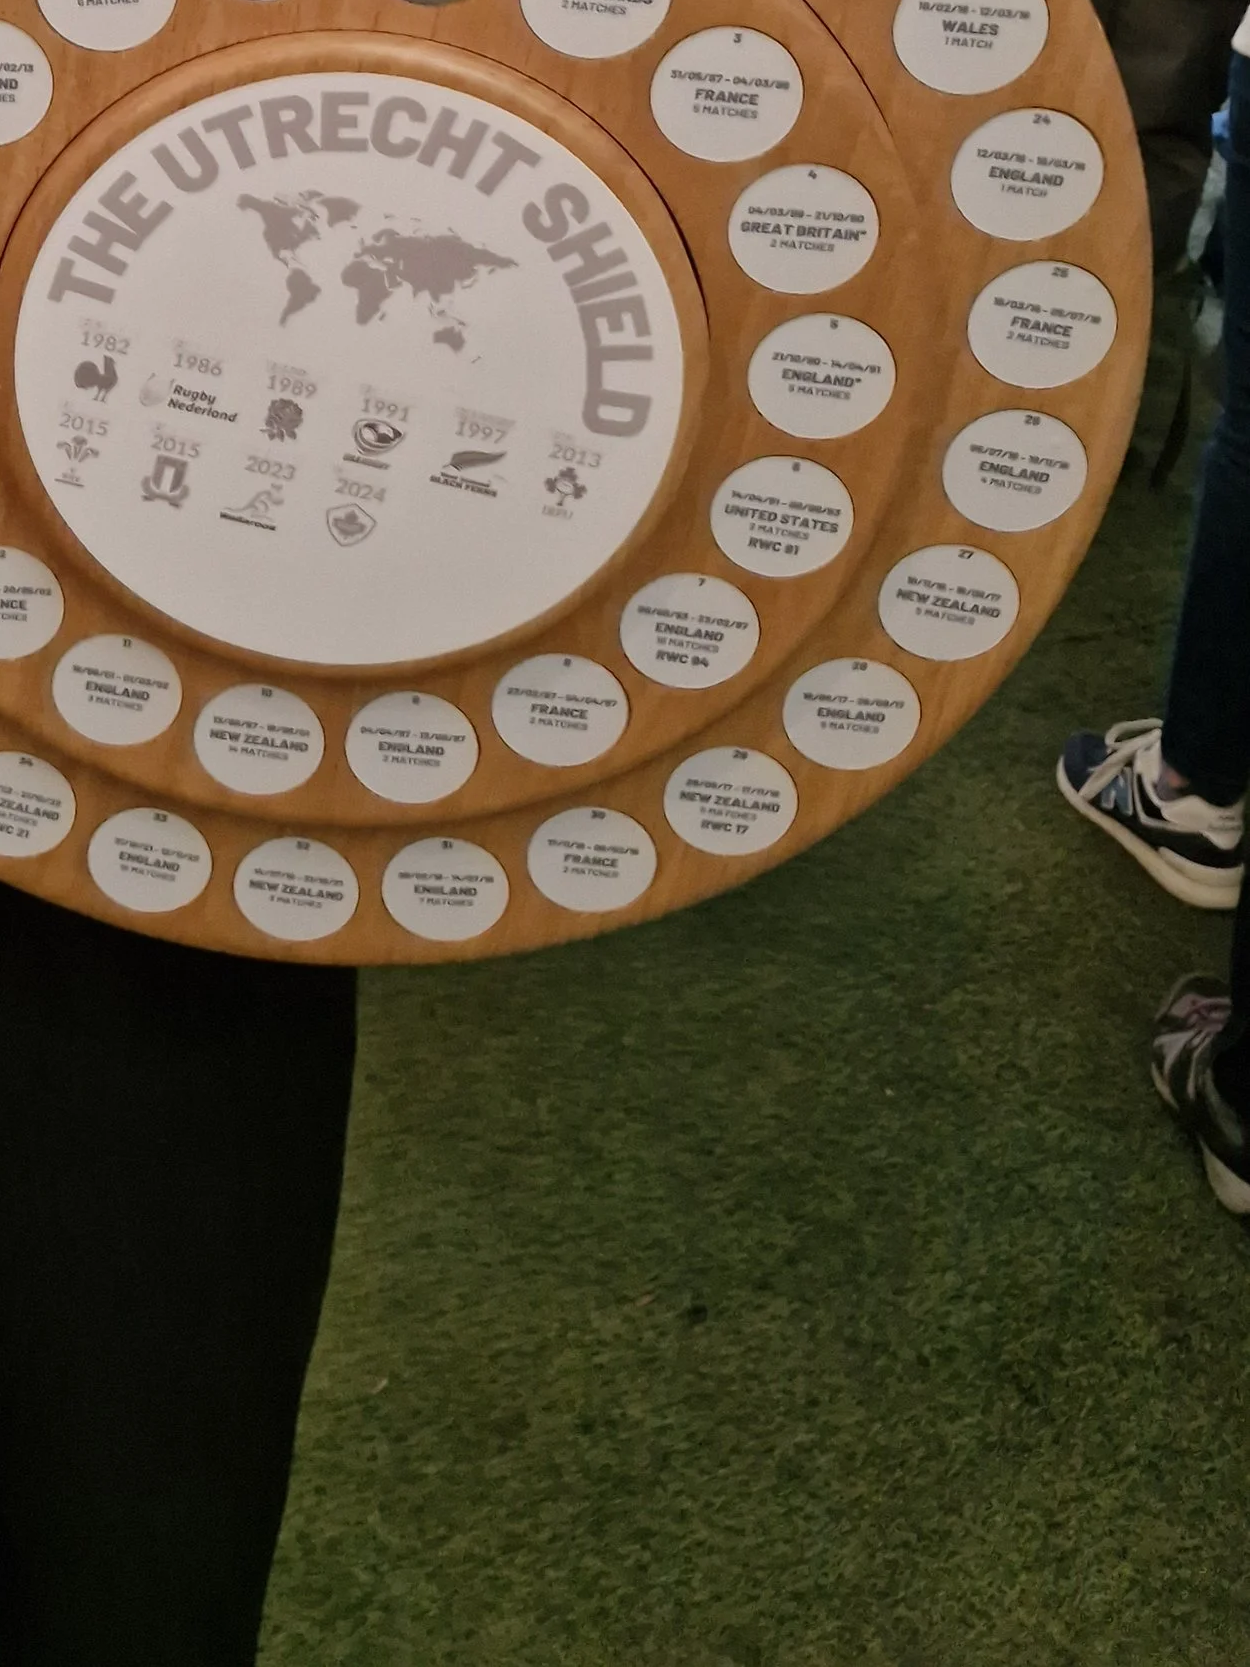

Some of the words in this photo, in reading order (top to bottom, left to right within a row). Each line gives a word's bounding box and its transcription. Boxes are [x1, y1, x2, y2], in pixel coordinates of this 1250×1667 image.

[561, 0, 569, 8] 2
[571, 0, 627, 15] MATCHES
[942, 20, 999, 36] WALES
[734, 34, 742, 43] 3
[951, 38, 993, 49] MATCH
[695, 88, 759, 106] FRANCE
[702, 105, 758, 119] MATCHES
[808, 170, 817, 179] 4
[988, 166, 1063, 187] ENGLAND
[1007, 185, 1047, 198] MATCH
[741, 221, 794, 235] GREAT
[770, 239, 777, 247] 2
[780, 241, 835, 252] MATCHES
[47, 170, 173, 305] THE
[151, 92, 541, 197] UTRECHT
[521, 183, 654, 438] SHIELD
[1010, 316, 1073, 337] FRANCE
[81, 331, 130, 355] 1982
[174, 353, 222, 376] 1986
[173, 385, 216, 405] Rugby
[268, 375, 317, 398] 1989
[798, 386, 850, 400] MATCHES
[361, 398, 409, 422] 1991
[59, 413, 109, 436] 2015
[456, 421, 508, 444] 1997
[151, 434, 200, 459] 2015
[549, 444, 601, 468] 2013
[245, 455, 296, 481] 2023
[979, 461, 1050, 483] ENGLAND
[336, 479, 386, 502] 2024
[724, 504, 777, 522] UNITED
[780, 513, 839, 533] STATES
[748, 537, 782, 553] RWC
[958, 549, 974, 559] 27
[698, 577, 705, 586] 7
[896, 589, 930, 604] NEW
[932, 597, 1000, 618] ZEALAND
[655, 622, 724, 642] ENGLAND
[656, 650, 688, 664] RWC
[86, 681, 150, 701] ENGLAND
[530, 704, 588, 720] FRANCE
[817, 707, 885, 723] ENGLAND
[210, 729, 241, 742] NEW
[244, 734, 308, 752] ZEALAND
[378, 741, 444, 756] ENGLAND
[0, 799, 60, 821] ZEALAND
[679, 791, 711, 804] NEW
[714, 795, 781, 813] ZEALAND
[701, 819, 732, 832] RWC
[735, 824, 748, 834] 17
[119, 851, 179, 872] ENGLAND
[564, 854, 618, 868] FRANCE
[282, 884, 344, 901] ZEALAND
